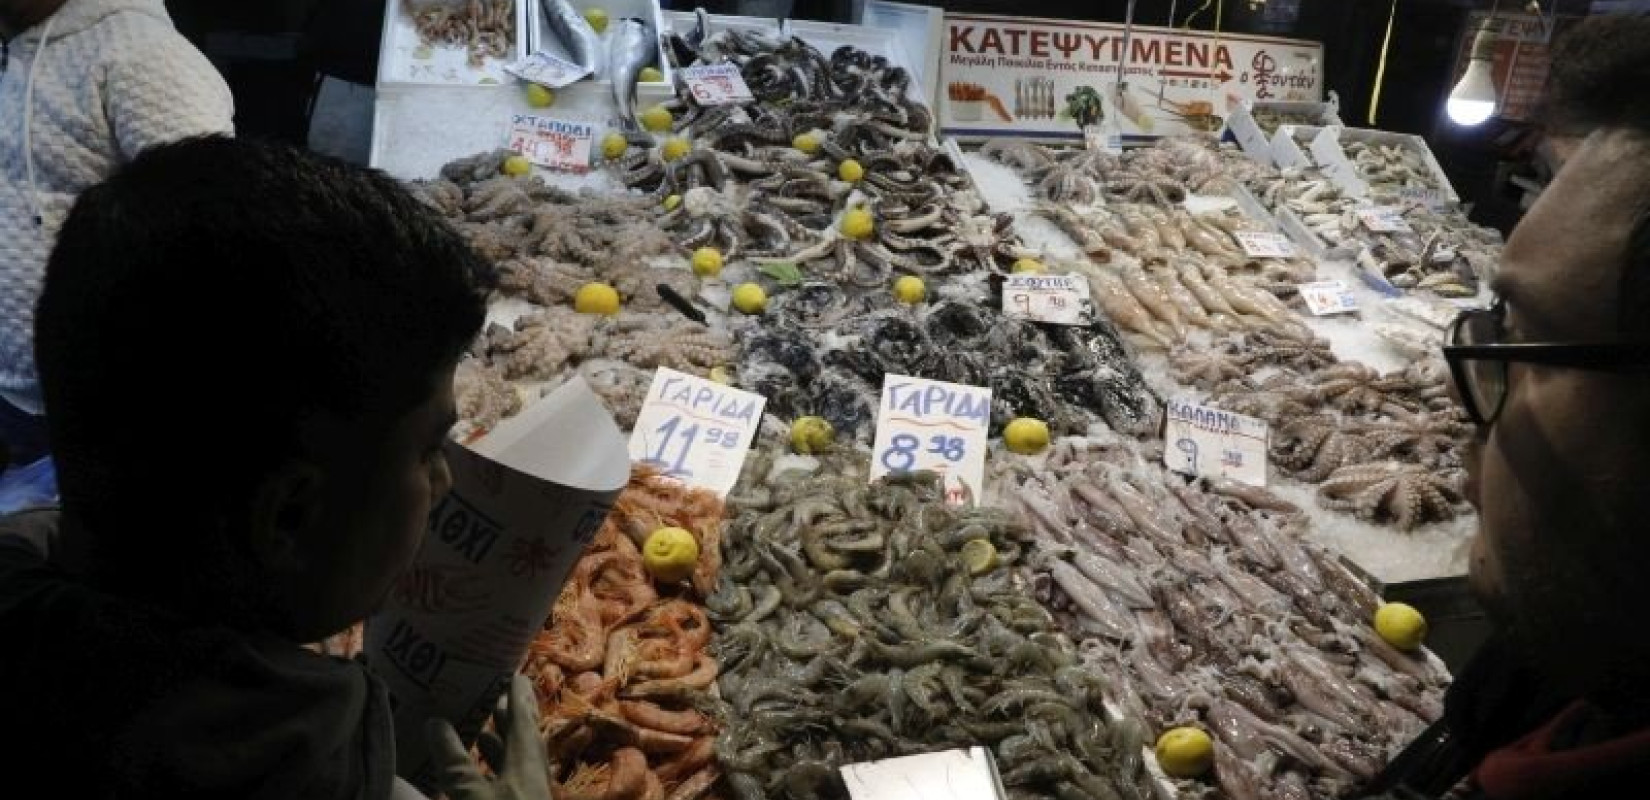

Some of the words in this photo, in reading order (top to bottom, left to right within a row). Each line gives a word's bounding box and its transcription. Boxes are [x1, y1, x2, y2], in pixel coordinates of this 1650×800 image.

[949, 25, 1234, 69] ΚΑΤΕΨΥΓΜΕΝΑ
[658, 377, 757, 426] ΓΑΡΙΔΑ
[888, 382, 990, 426] ΓΑΡΙΔΑ
[640, 415, 699, 478] 11
[703, 427, 740, 449] 98
[880, 432, 920, 474] 8
